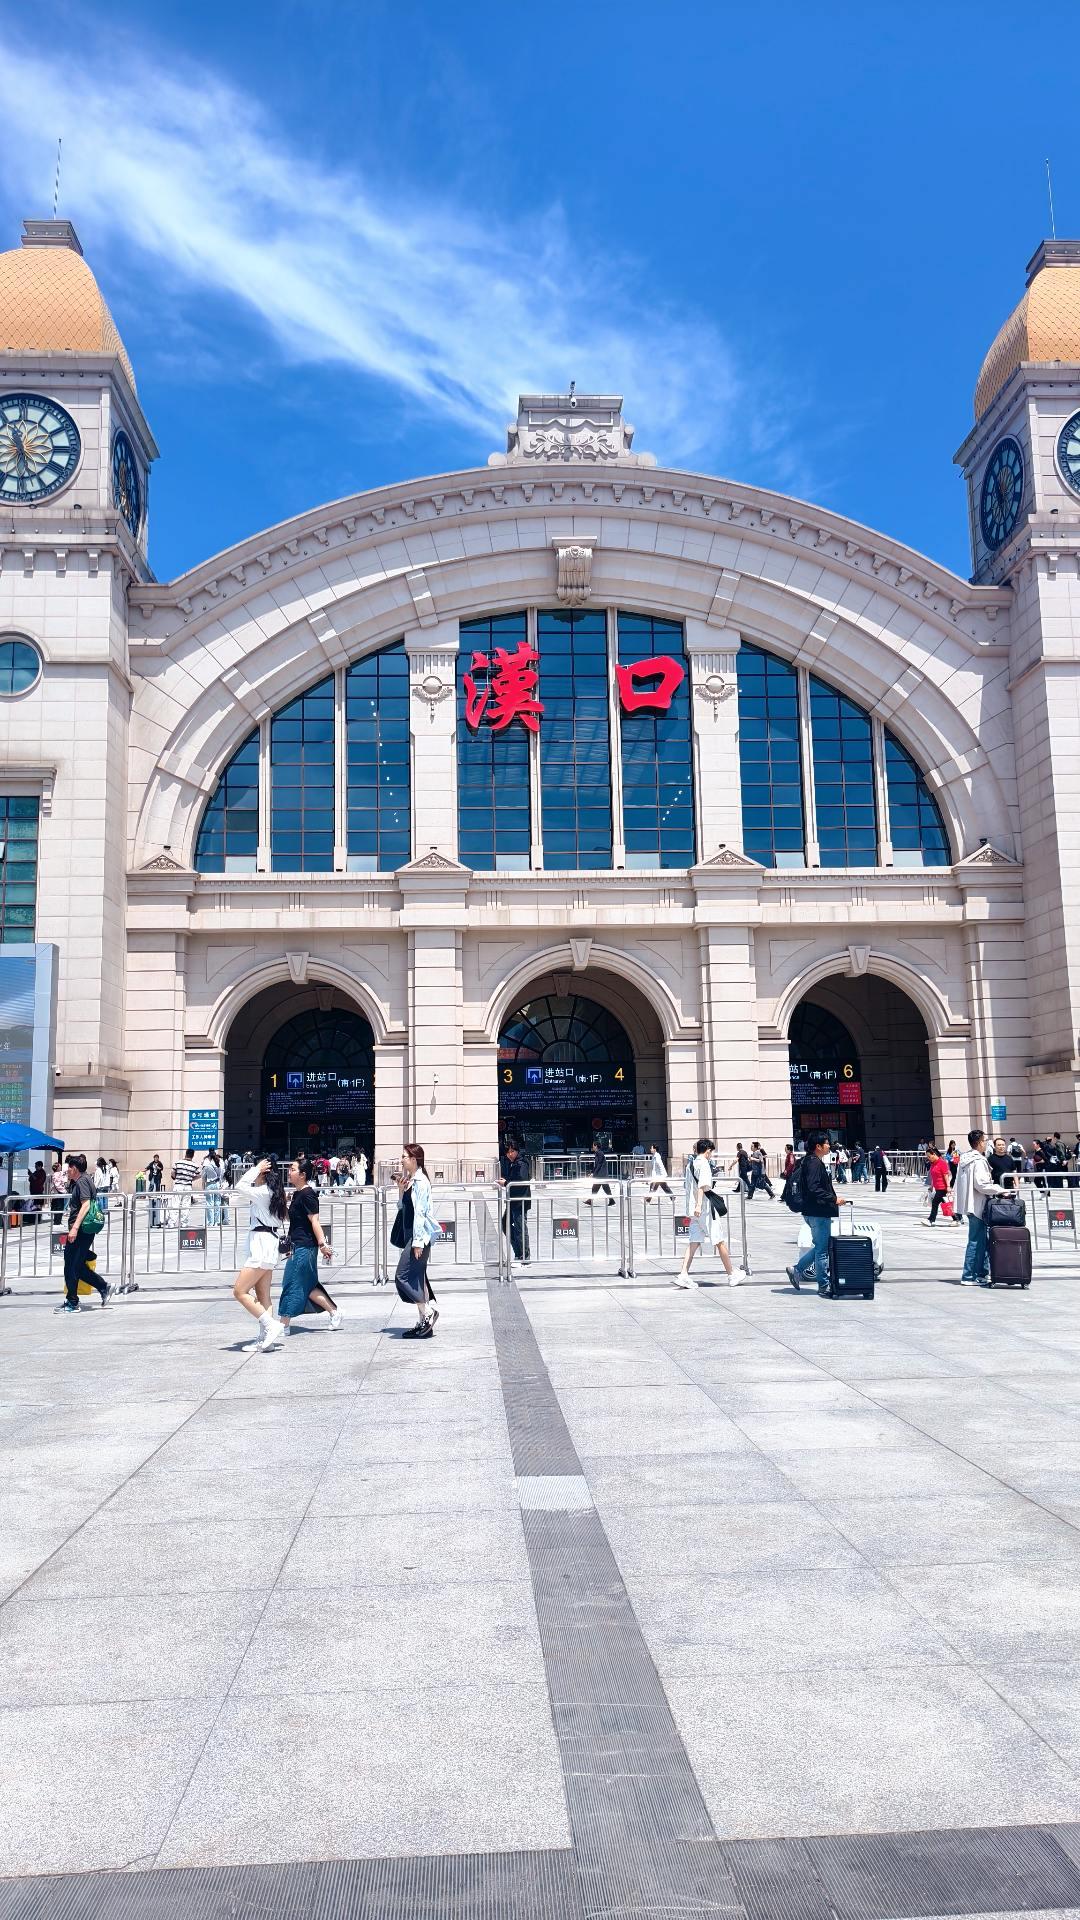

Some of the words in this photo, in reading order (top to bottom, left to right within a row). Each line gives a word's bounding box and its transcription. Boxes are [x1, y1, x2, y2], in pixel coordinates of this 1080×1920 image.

[306, 1072, 337, 1082] 进站口
[503, 1069, 513, 1083] 3
[545, 1067, 574, 1078] 进站口
[614, 1067, 625, 1081] 4
[844, 1064, 854, 1079] 6
[270, 1073, 278, 1088] 1
[555, 1228, 576, 1236] 汉口站
